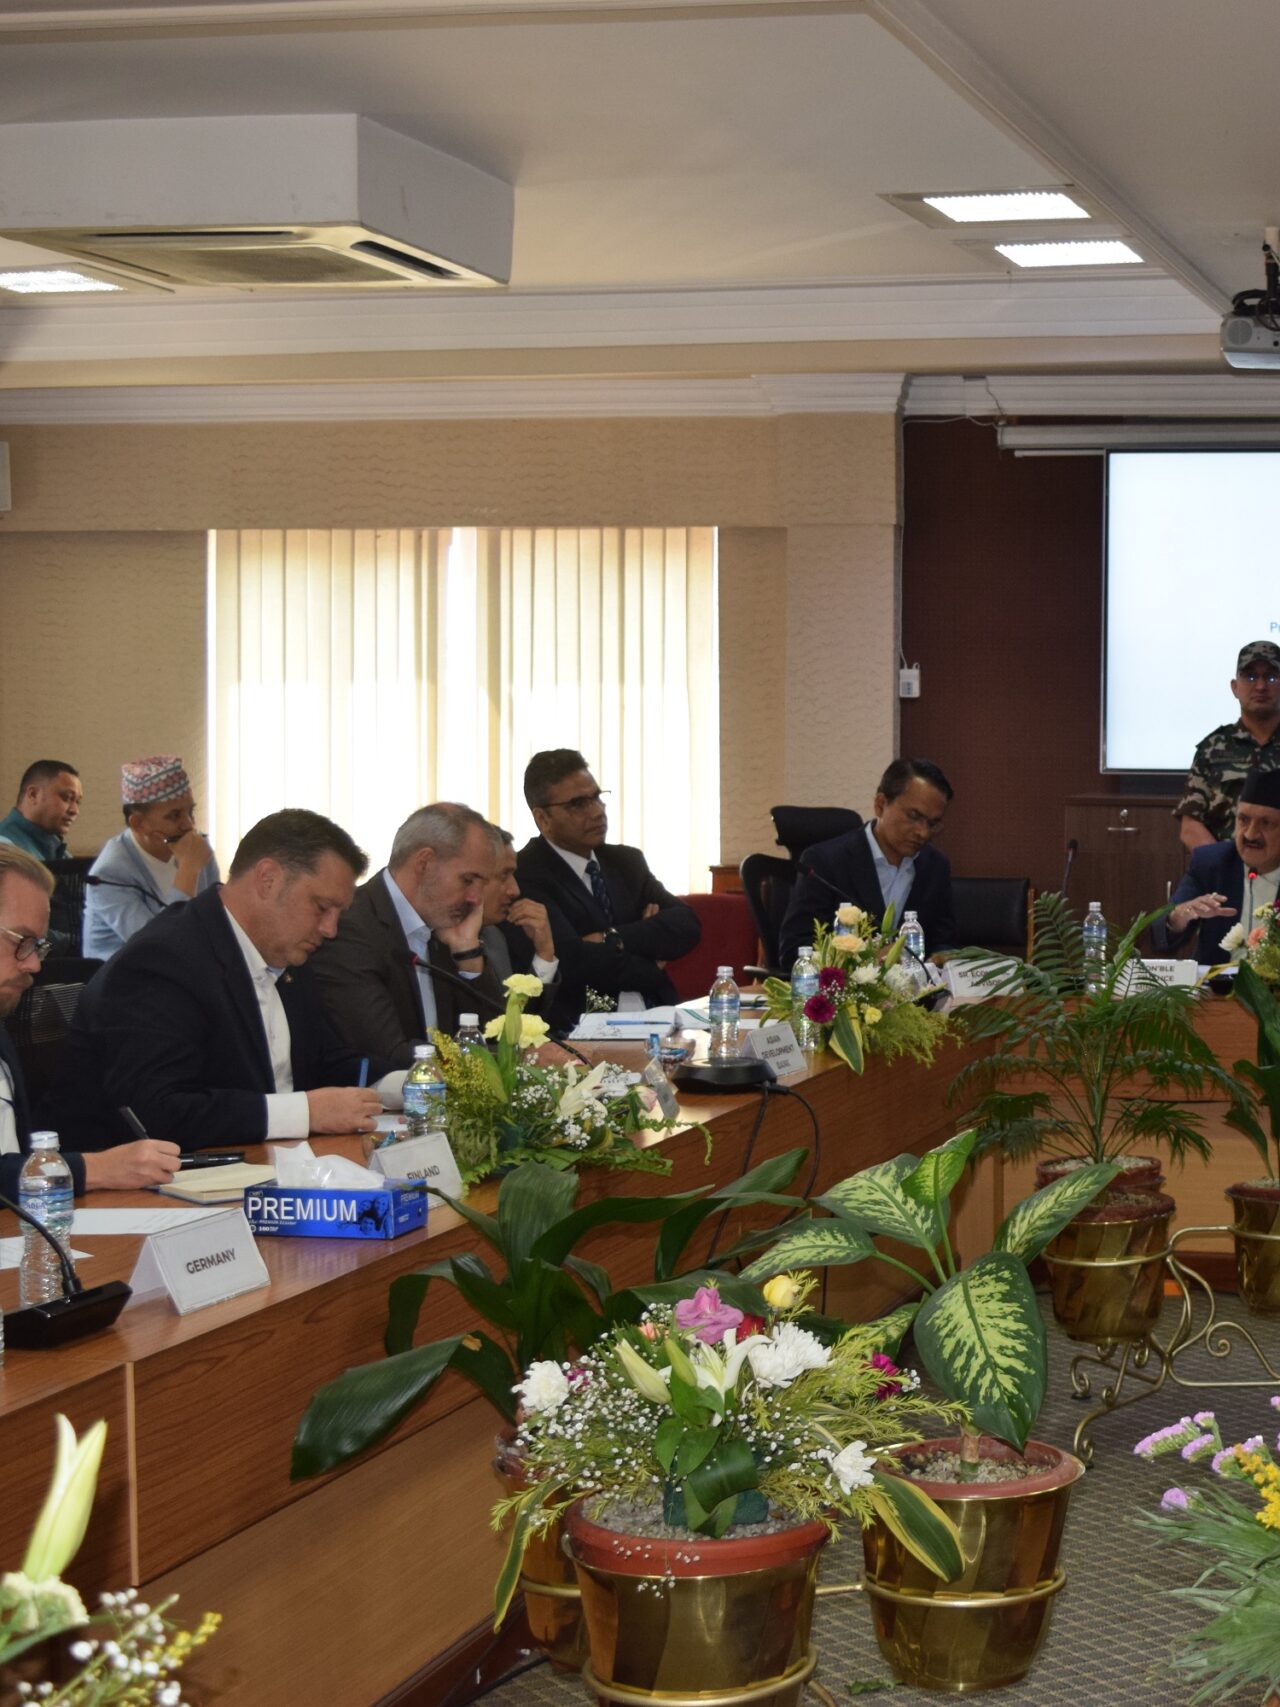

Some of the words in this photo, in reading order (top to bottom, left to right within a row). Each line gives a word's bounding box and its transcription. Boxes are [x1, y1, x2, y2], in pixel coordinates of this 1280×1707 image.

[407, 1165, 440, 1180] FINLAND
[248, 1197, 357, 1221] PREMIUM
[186, 1248, 236, 1275] GERMANY
